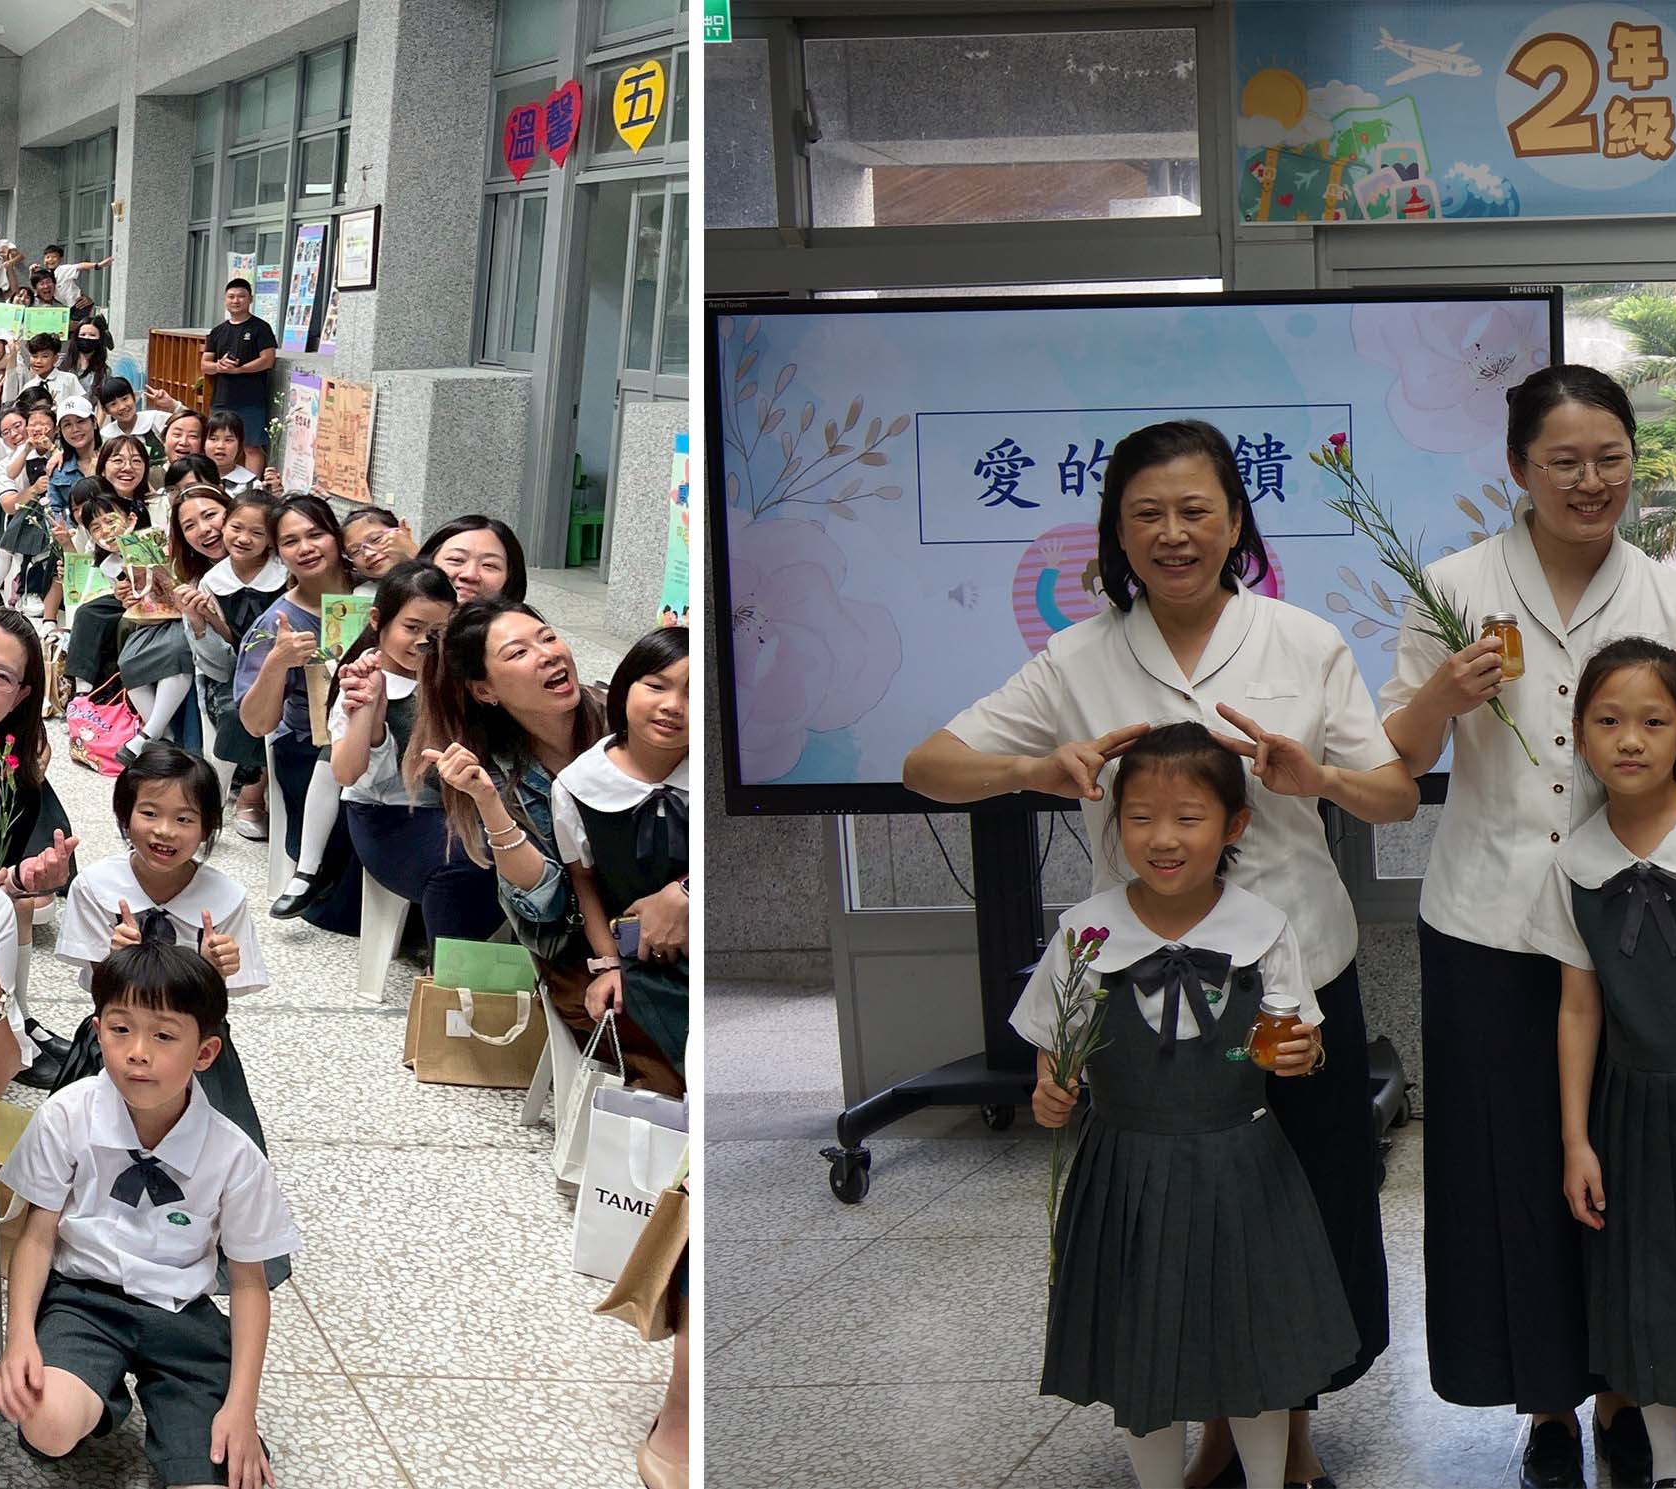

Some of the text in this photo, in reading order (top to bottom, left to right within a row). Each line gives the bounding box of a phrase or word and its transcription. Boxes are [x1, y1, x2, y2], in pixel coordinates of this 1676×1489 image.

[620, 70, 656, 129] 五
[1506, 32, 1600, 158] 2
[1603, 21, 1676, 160] 年級
[974, 433, 1293, 508] 愛的饋
